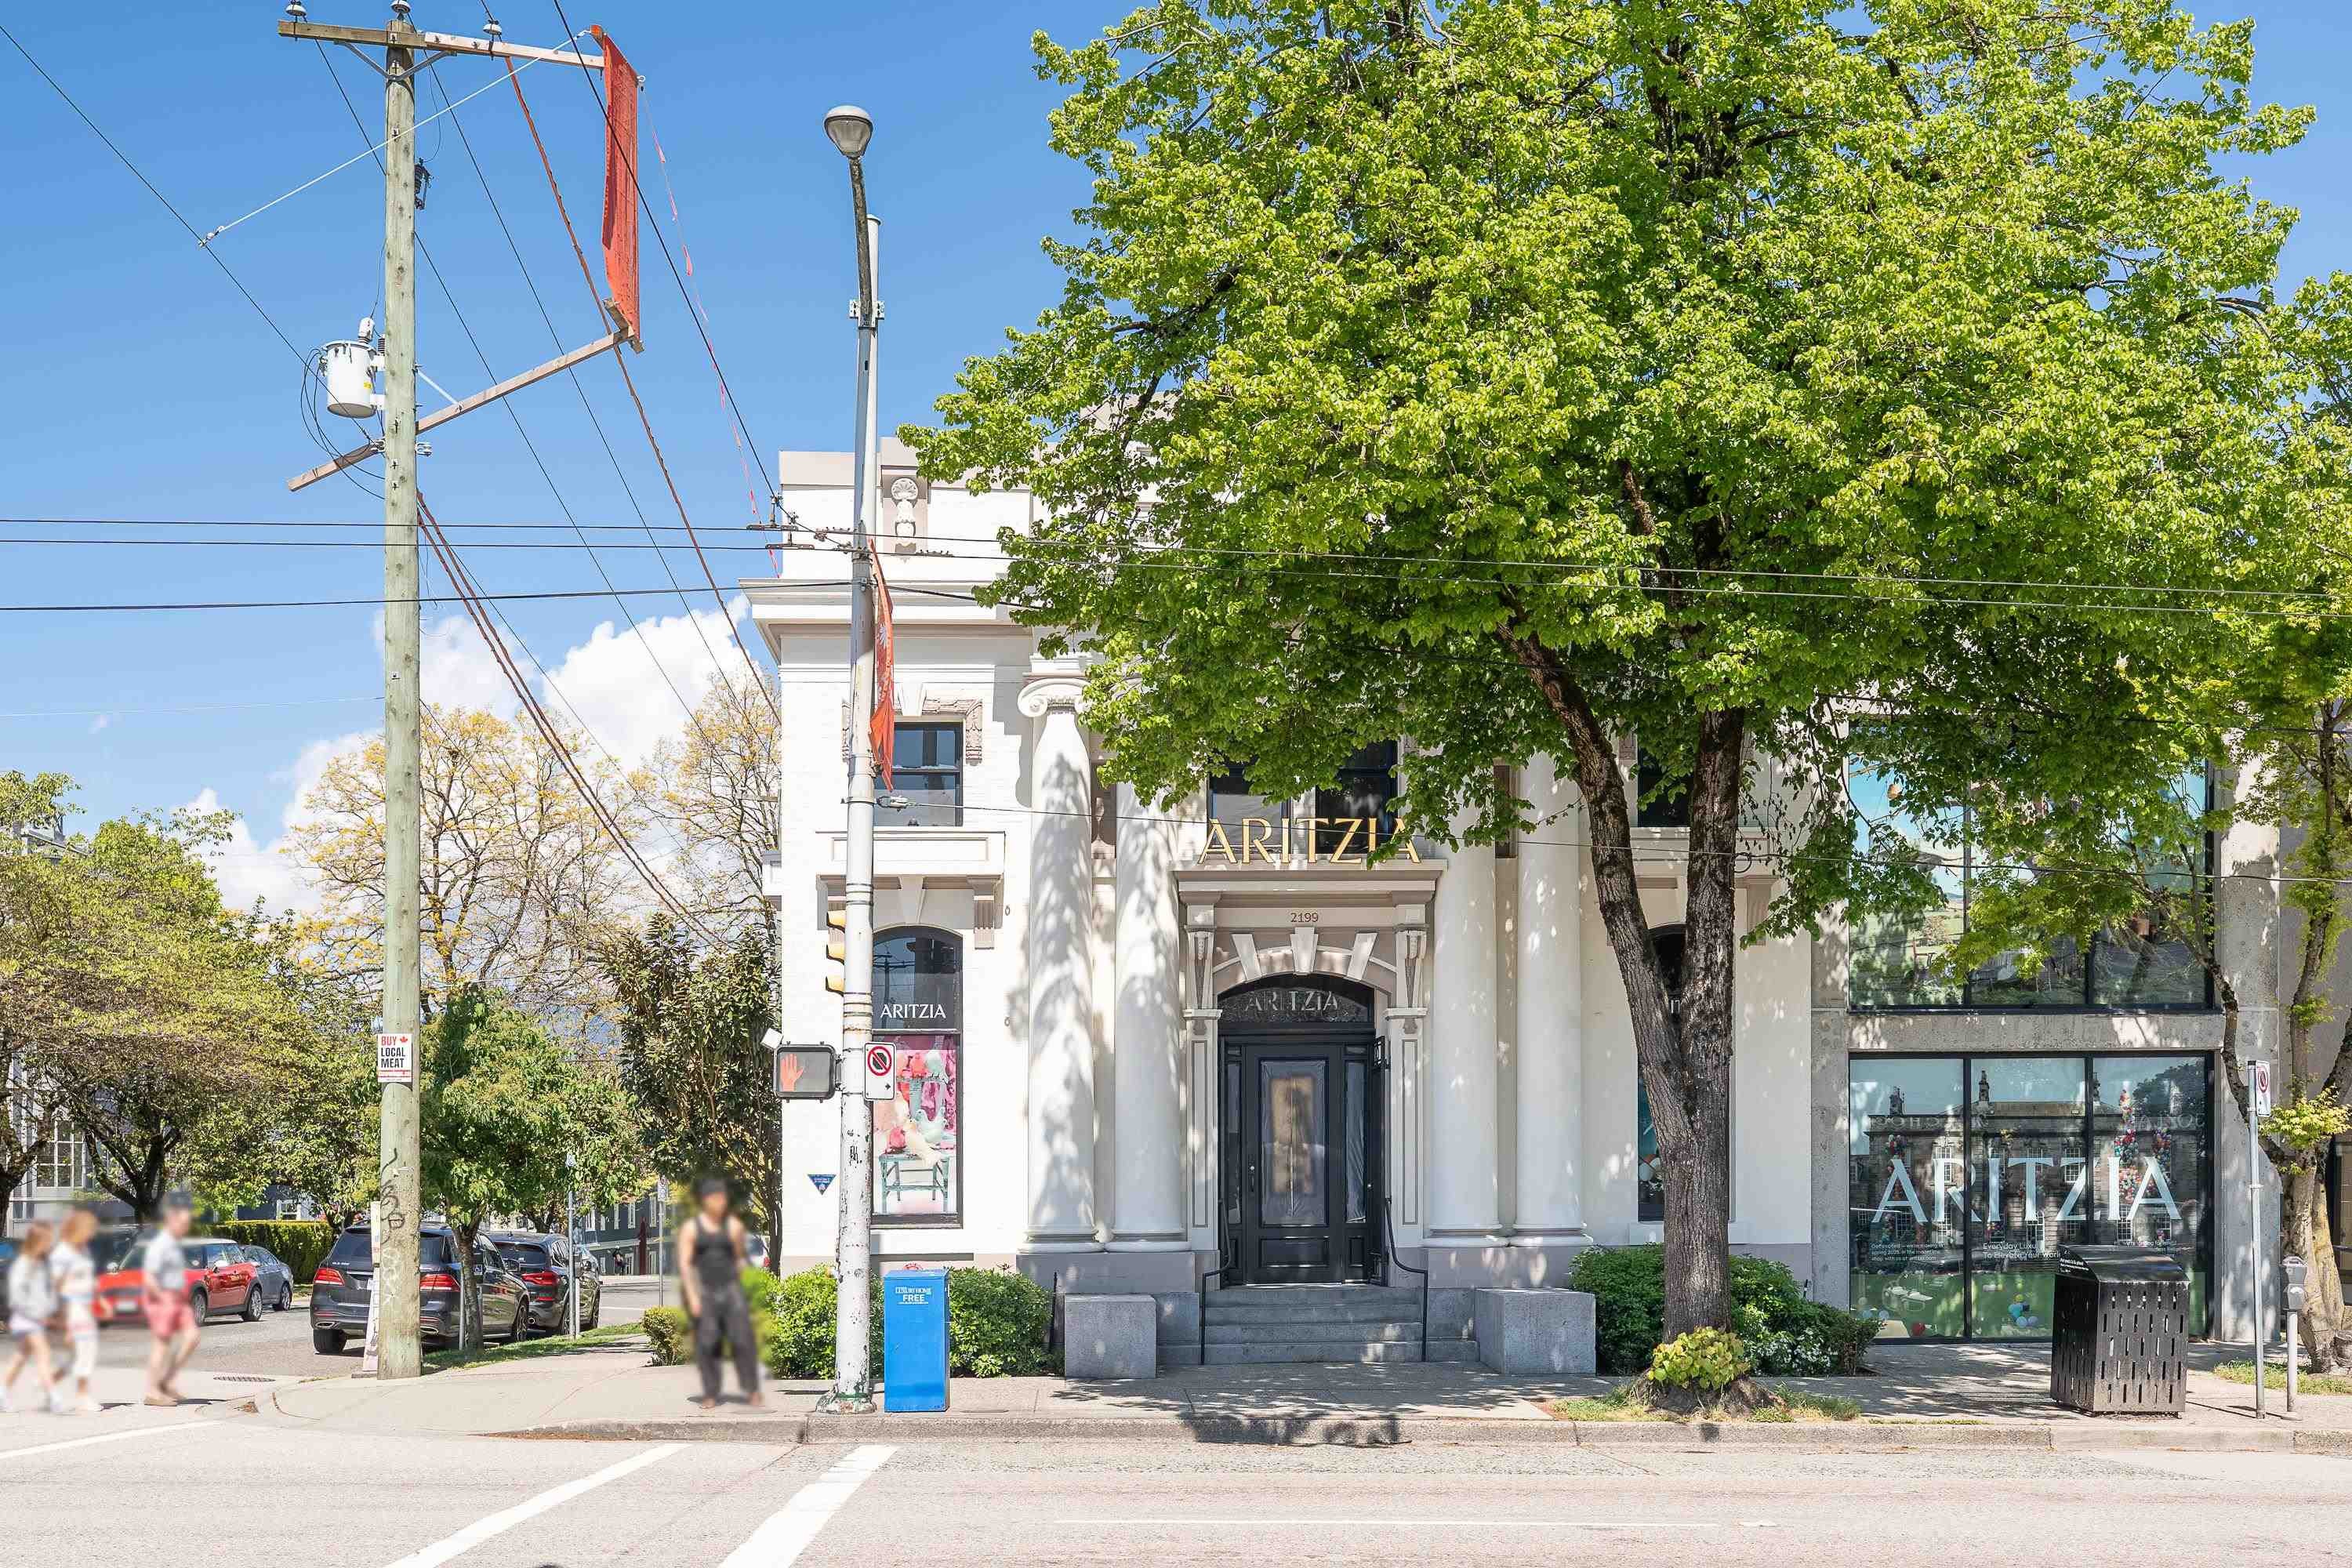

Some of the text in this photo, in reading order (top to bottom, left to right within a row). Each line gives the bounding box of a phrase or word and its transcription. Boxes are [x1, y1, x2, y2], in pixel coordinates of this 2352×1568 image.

[1197, 817, 1421, 864] ARITZIA
[1290, 912, 1319, 923] 2199
[1244, 990, 1338, 1011] ARITZIA
[880, 1003, 947, 1019] ARITZIA
[381, 1036, 397, 1046] BUY
[381, 1047, 406, 1057] LOCAL
[381, 1058, 405, 1068] MEAT
[1871, 1156, 2183, 1223] ARITZIA
[1983, 1242, 2017, 1250] Everyday
